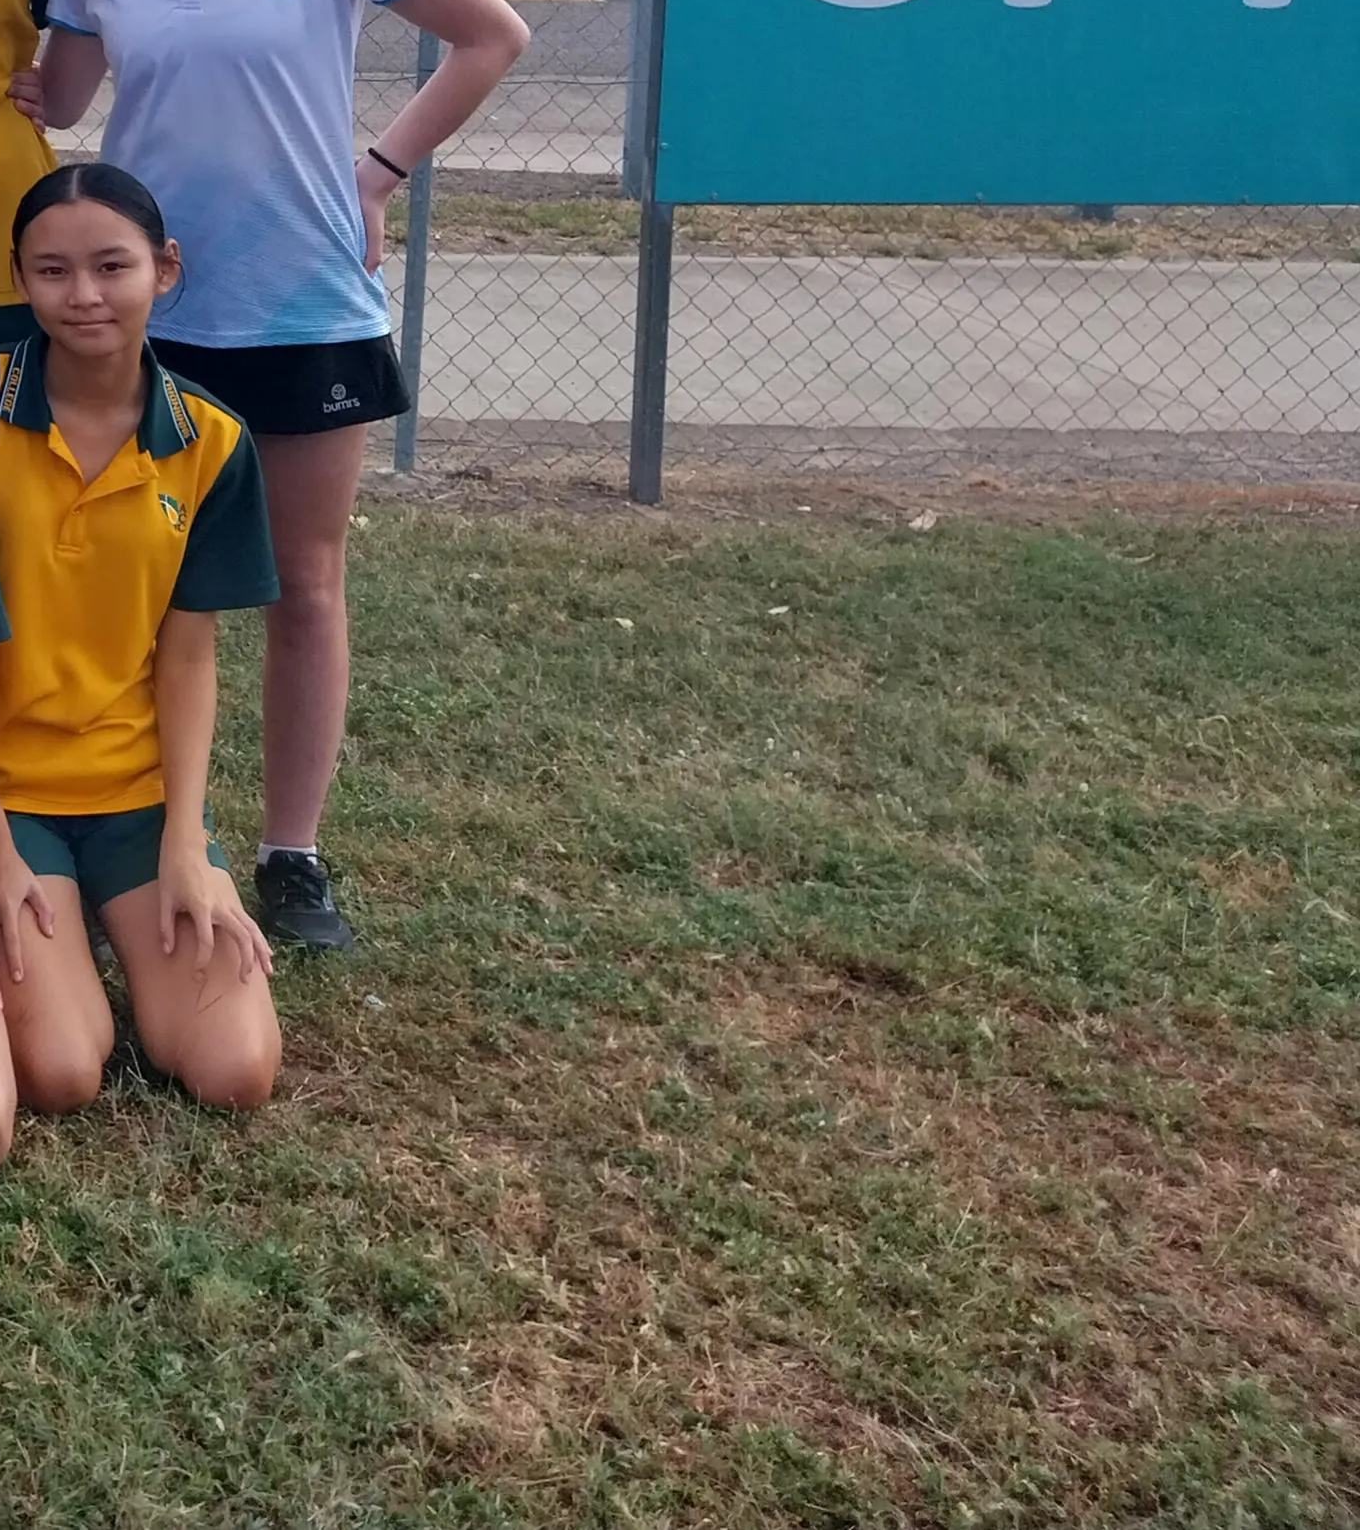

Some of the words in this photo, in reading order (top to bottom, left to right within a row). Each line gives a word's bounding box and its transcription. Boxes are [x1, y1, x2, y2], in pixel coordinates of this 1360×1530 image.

[2, 367, 21, 412] COLLEGE
[323, 395, 361, 414] bumrs
[177, 504, 188, 534] ACC
